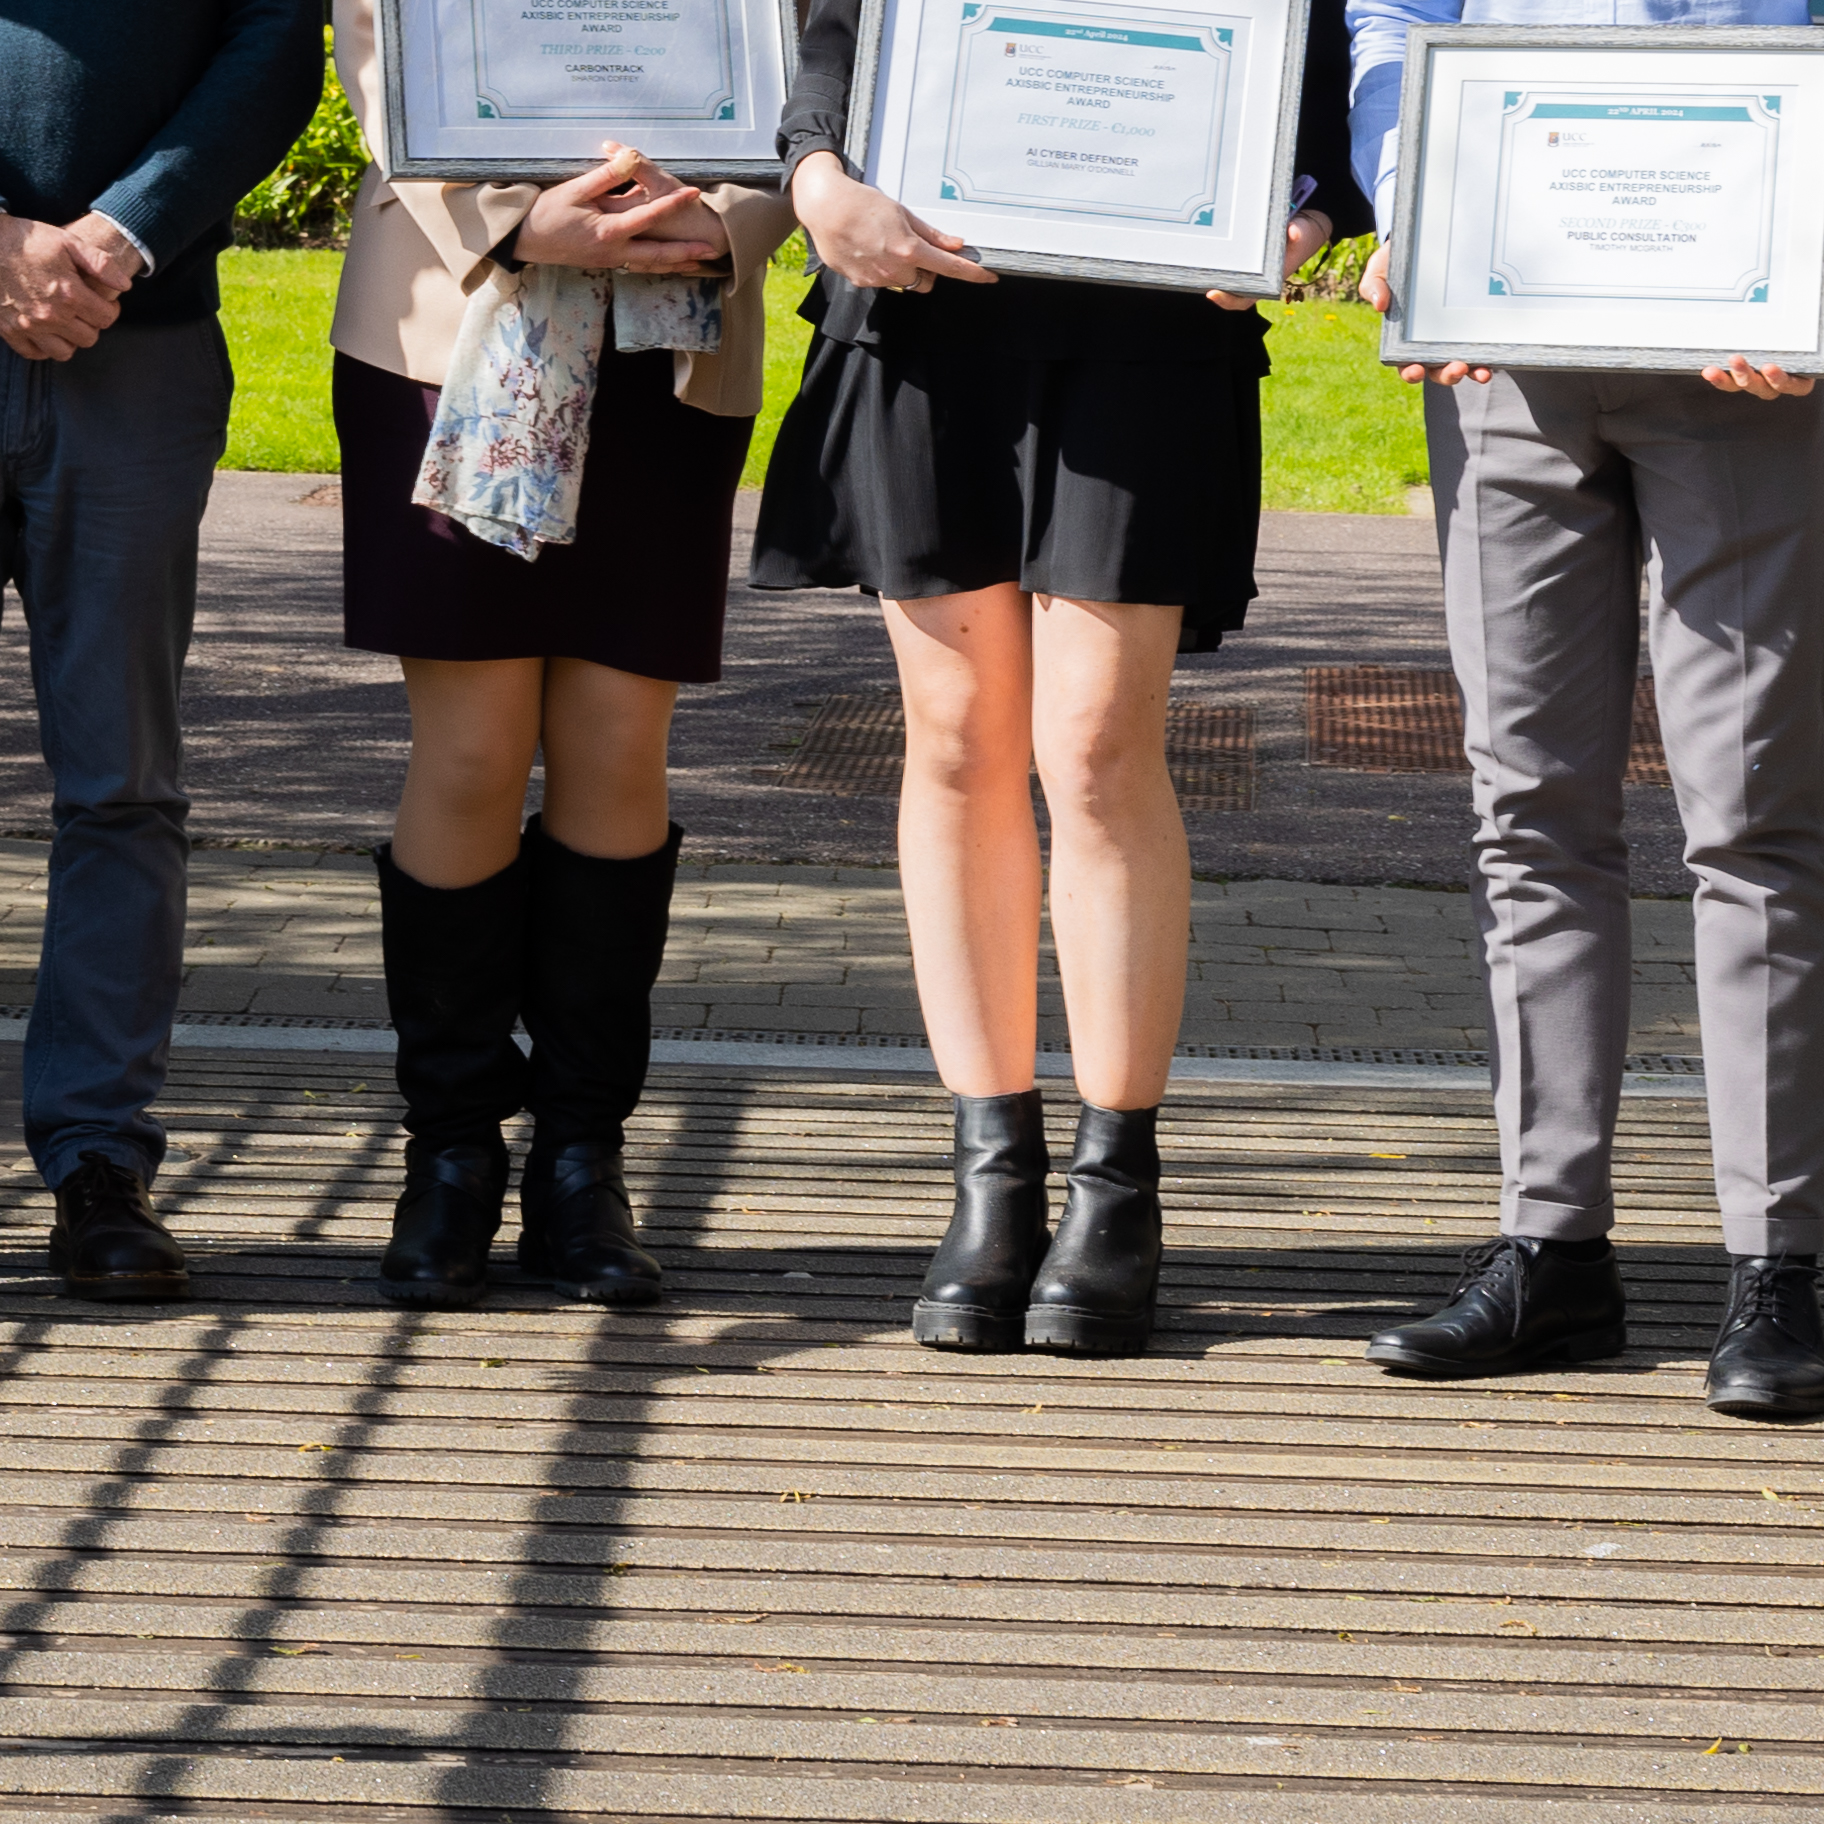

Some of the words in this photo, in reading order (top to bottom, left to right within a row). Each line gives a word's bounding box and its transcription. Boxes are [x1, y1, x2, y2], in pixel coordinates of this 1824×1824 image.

[531, 0, 554, 8] UCC
[557, 0, 618, 9] COMPUTER
[622, 0, 668, 10] SCIENCE
[521, 11, 564, 20] AXISBIC
[568, 12, 680, 22] ENTREPRENEURSHIP
[581, 24, 622, 33] AWARD
[540, 44, 583, 55] THIRD
[586, 45, 624, 56] PRIZE
[634, 45, 666, 56] €200
[1019, 44, 1044, 54] UCC
[565, 64, 644, 73] CARBONTRACK
[1019, 67, 1044, 77] UCC
[1046, 69, 1111, 84] COMPUTER
[1116, 76, 1165, 89] SCIENCE
[1006, 78, 1052, 90] AXISBIC
[1054, 83, 1175, 102] ENTREPRENEURSHIP
[1066, 97, 1110, 108] AWARD
[1630, 108, 1659, 116] APRIL
[1018, 113, 1058, 127] FIRST
[1058, 117, 1102, 132] PRIZE
[1112, 122, 1156, 137] €1,000
[1562, 132, 1586, 142] UCC
[1026, 148, 1038, 156] AI
[1040, 149, 1078, 161] CYBER
[1080, 153, 1139, 166] DEFENDER
[1026, 159, 1060, 168] GILLIAN
[1062, 162, 1086, 171] MARY
[1088, 165, 1136, 176] O'DONNELL
[1562, 169, 1587, 178] UCC
[1590, 170, 1656, 180] COMPUTER
[1660, 171, 1710, 181] SCIENCE
[1549, 182, 1596, 192] AXISBIC
[1599, 182, 1722, 194] ENTREPRENEURSHIP
[1612, 196, 1657, 206] AWARD
[1559, 217, 1616, 230] SECOND
[1619, 218, 1662, 230] PRIZE
[1673, 220, 1706, 232] €300
[1567, 232, 1608, 241] PUBLIC
[1610, 232, 1697, 242] CONSULTATION
[1590, 243, 1626, 251] TIMOTHY
